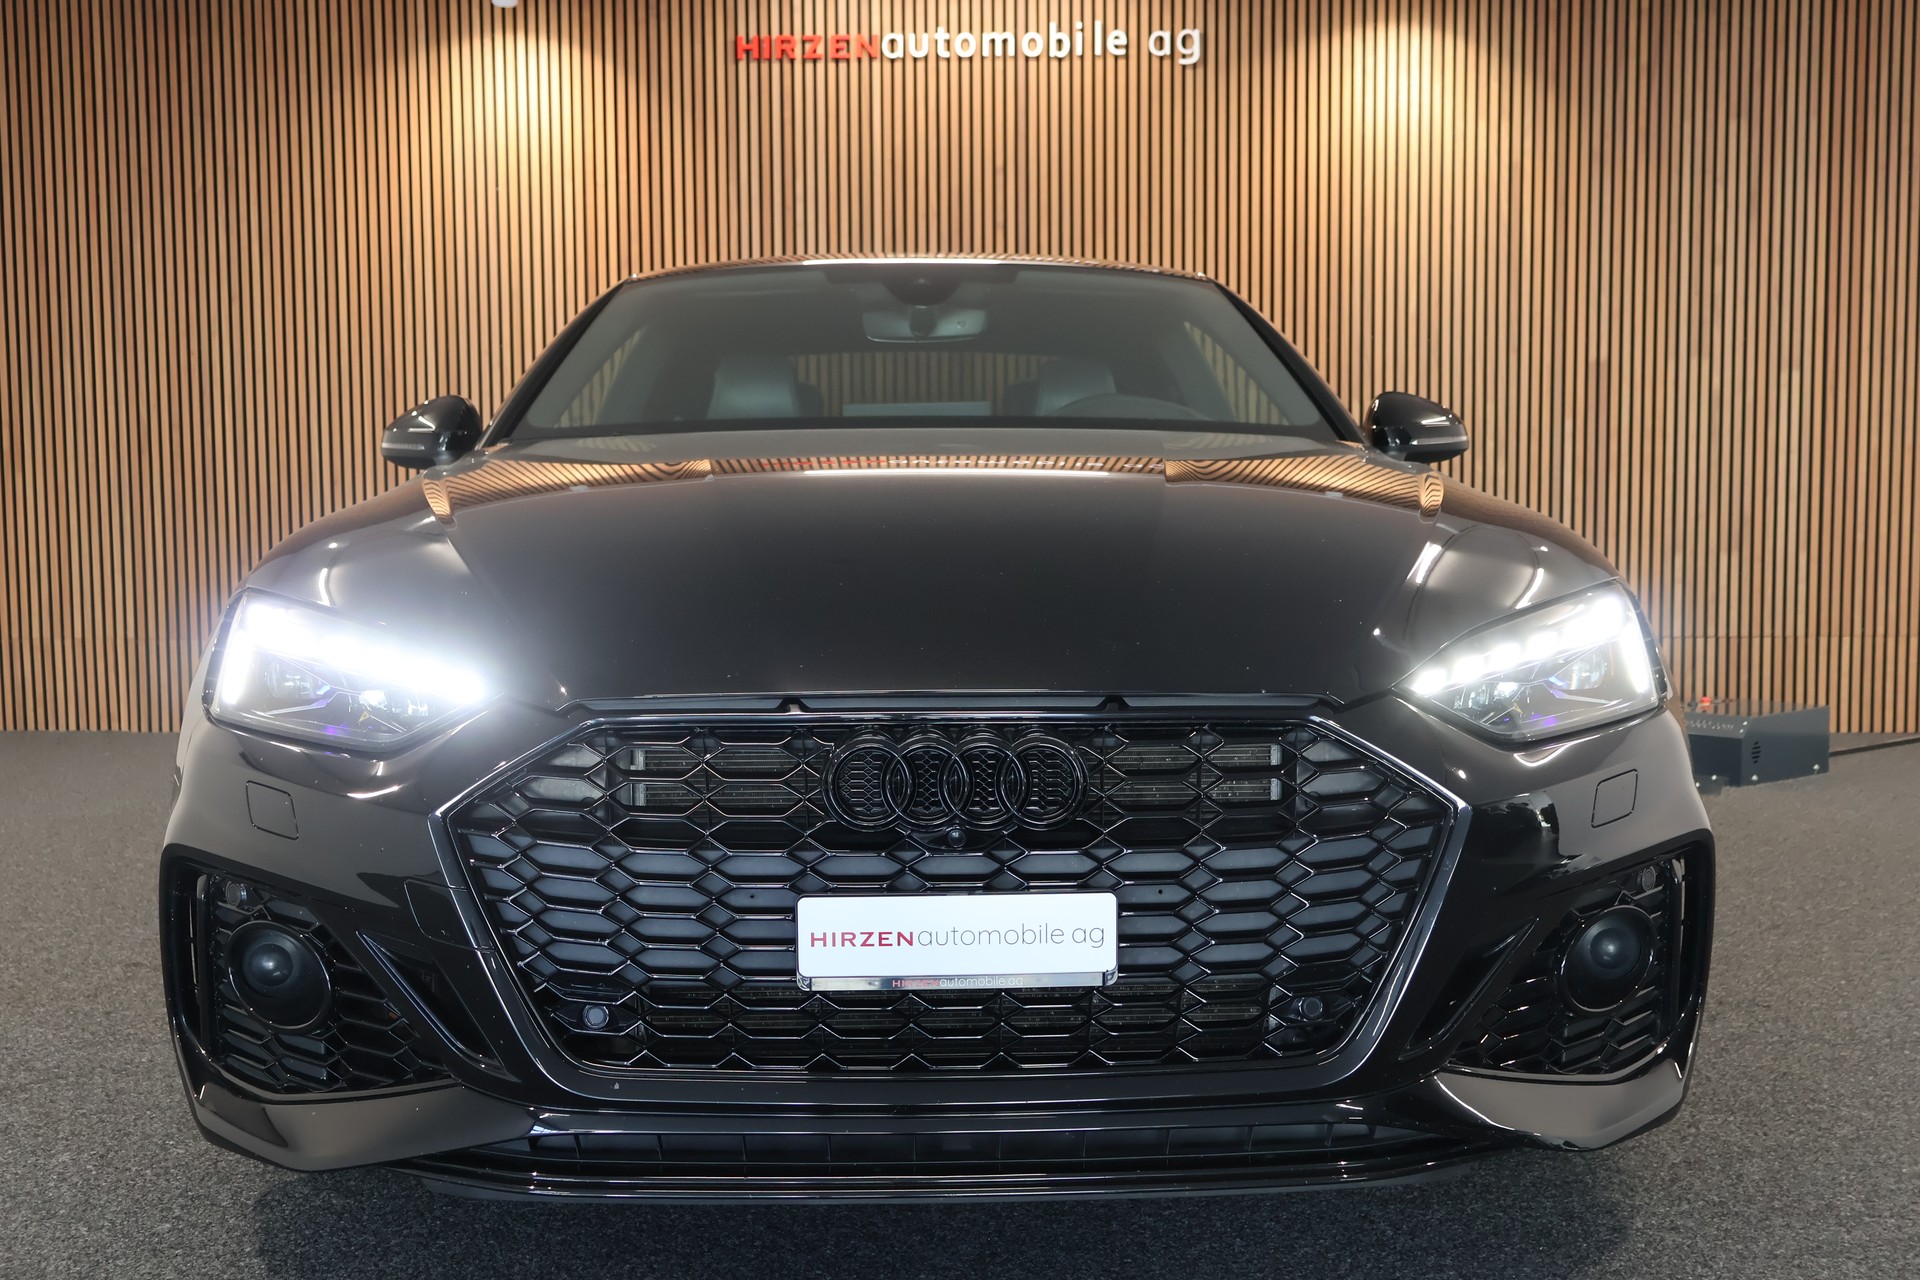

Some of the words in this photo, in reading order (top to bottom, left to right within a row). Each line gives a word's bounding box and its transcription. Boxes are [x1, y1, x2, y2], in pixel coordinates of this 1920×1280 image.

[1148, 27, 1201, 65] ag
[1071, 926, 1105, 949] ag
[1007, 976, 1024, 988] ag
